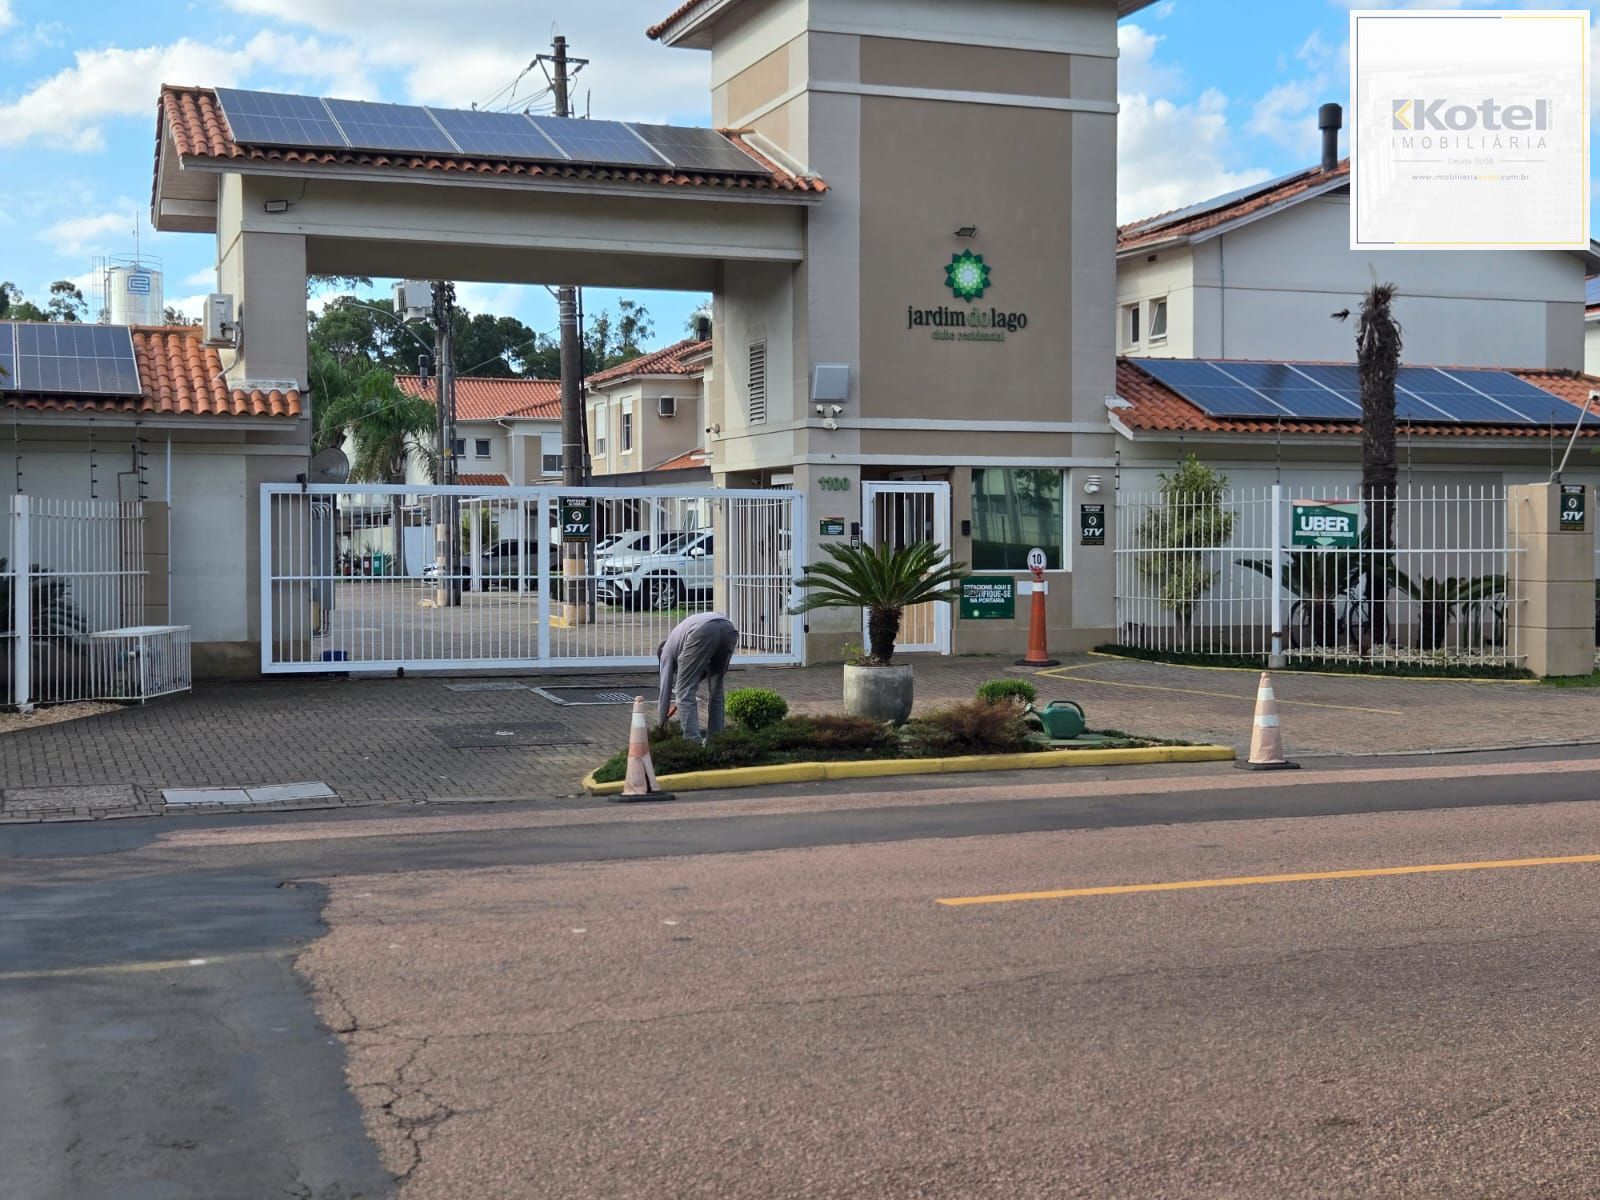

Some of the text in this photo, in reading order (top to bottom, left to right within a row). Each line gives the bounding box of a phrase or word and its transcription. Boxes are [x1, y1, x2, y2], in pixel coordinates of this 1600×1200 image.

[907, 305, 966, 330] jardim
[991, 308, 1028, 333] lago
[818, 475, 850, 491] 1100
[1560, 511, 1584, 521] STV
[564, 523, 590, 533] STV
[1300, 515, 1350, 532] UBER
[1082, 527, 1104, 537] STV
[1031, 553, 1042, 565] 10
